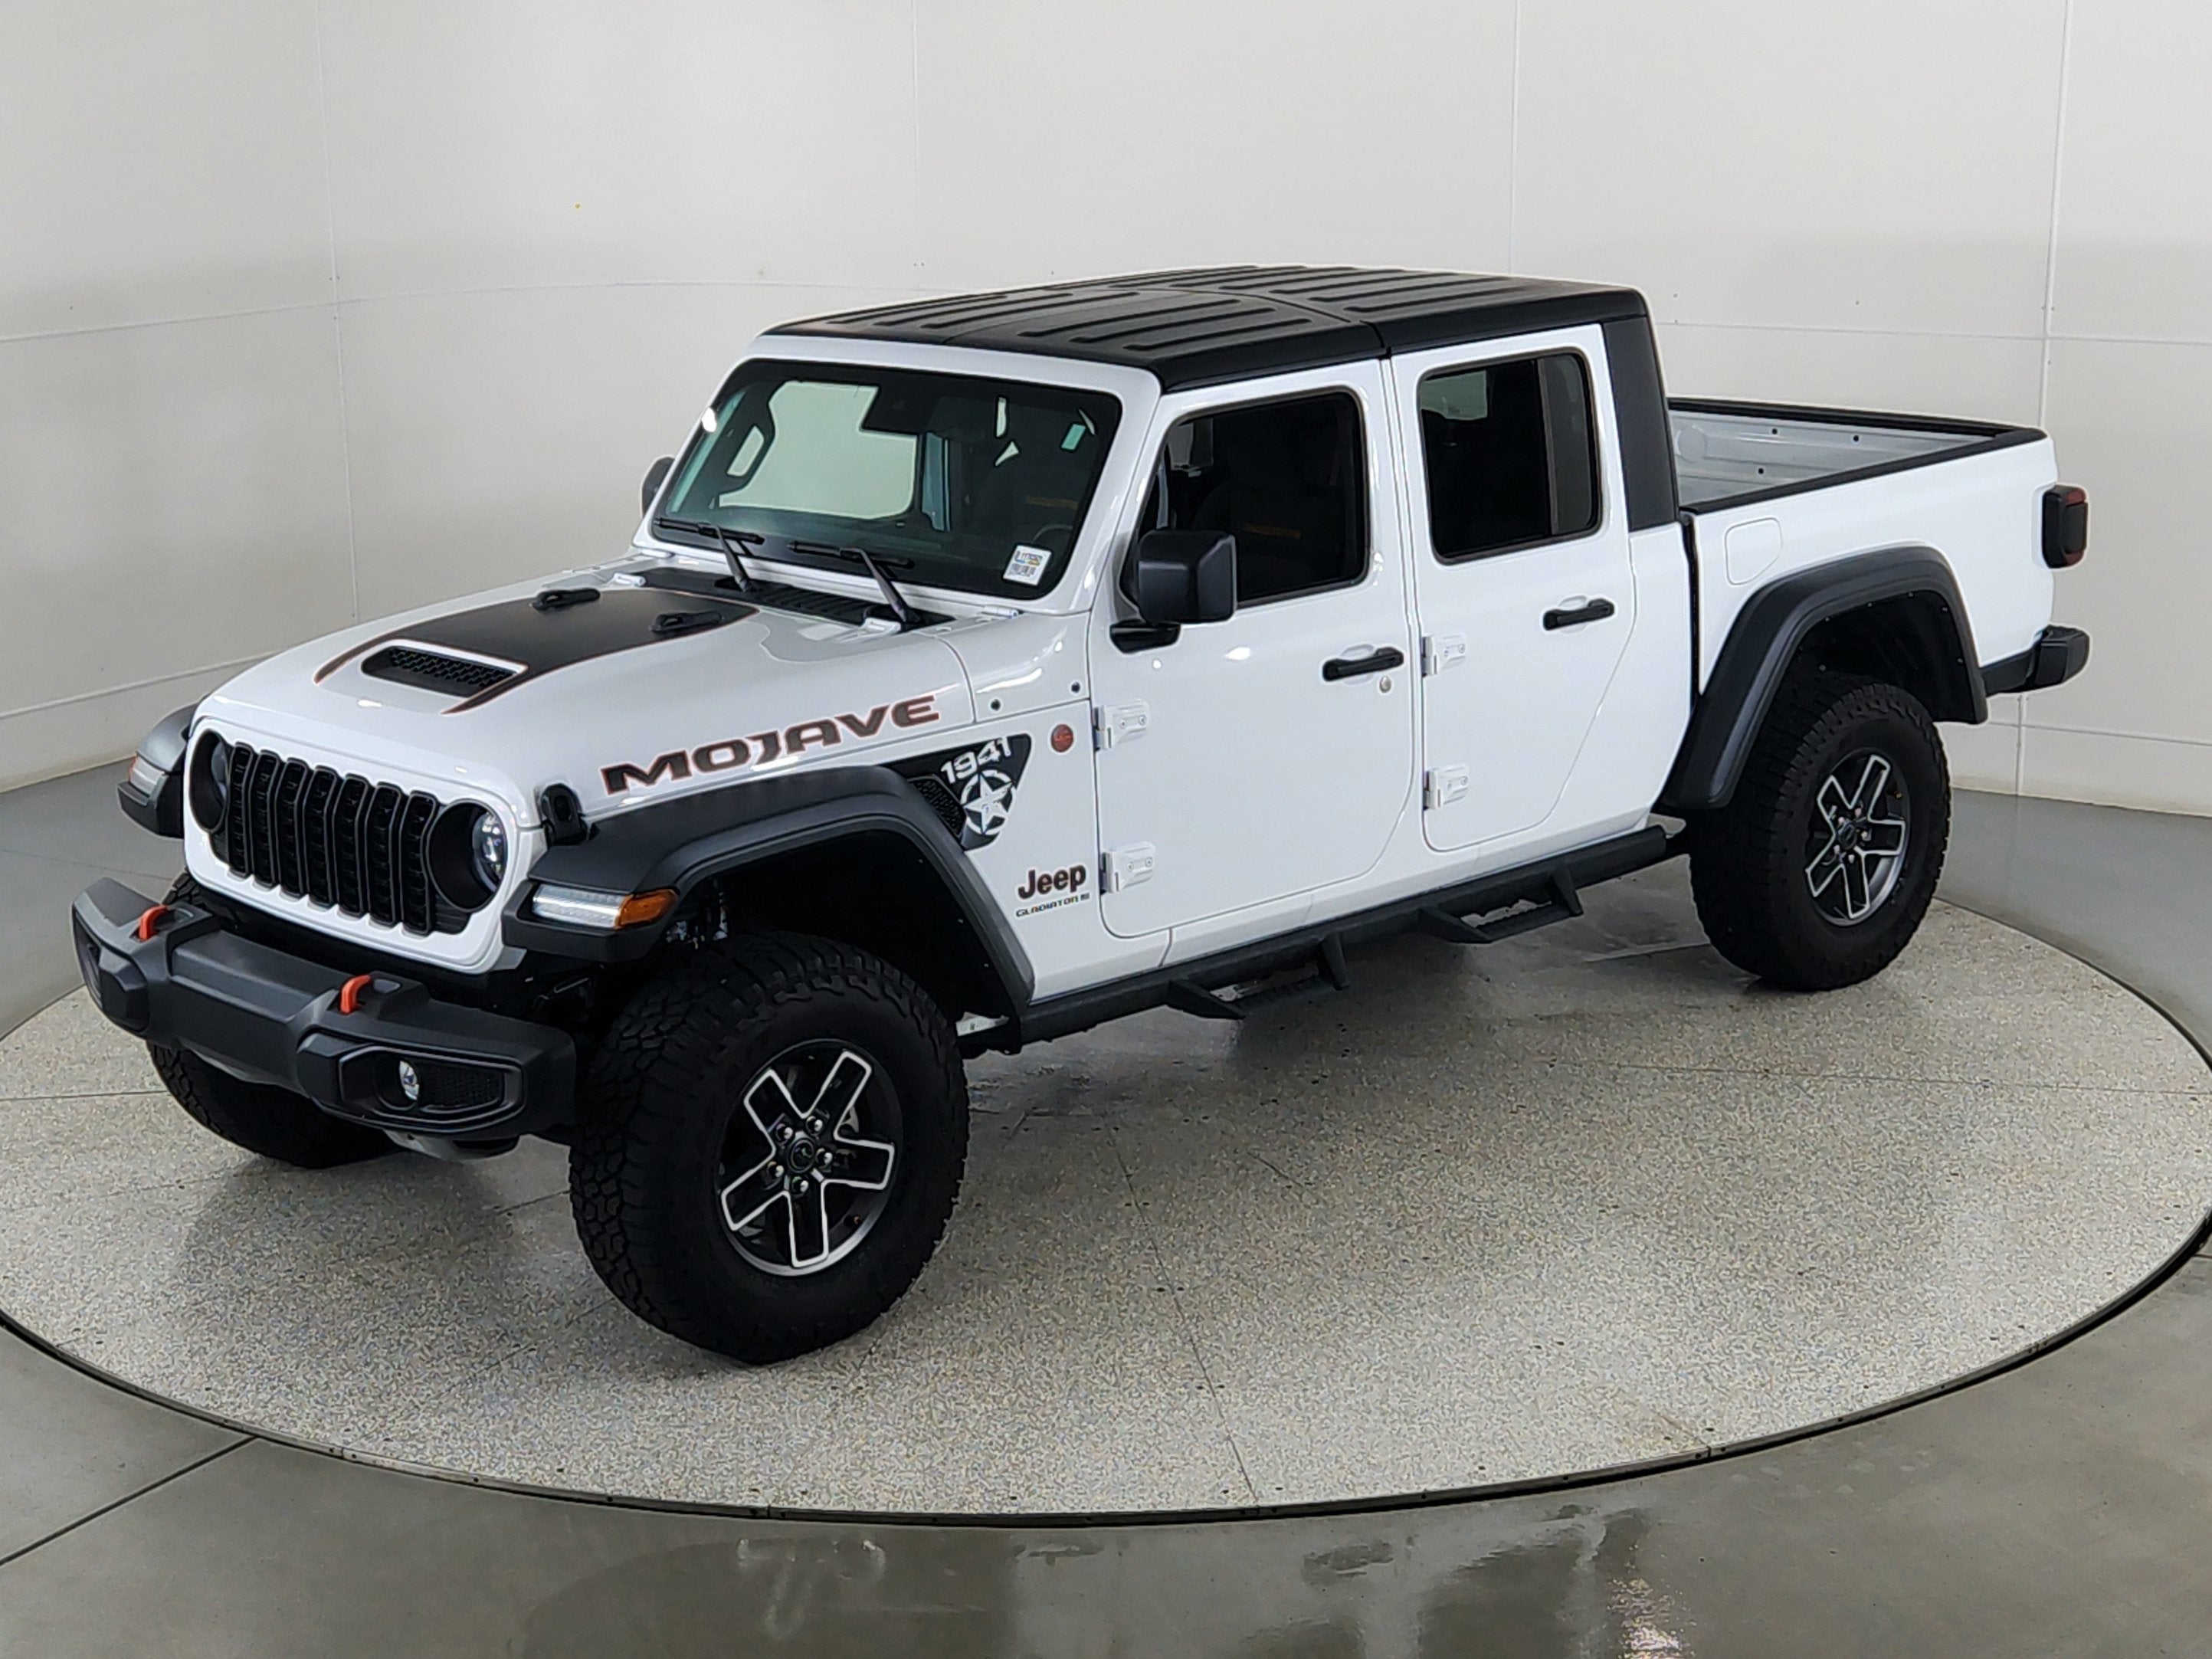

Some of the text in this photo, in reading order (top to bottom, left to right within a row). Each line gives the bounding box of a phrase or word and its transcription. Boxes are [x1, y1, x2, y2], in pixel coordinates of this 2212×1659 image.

[601, 694, 939, 795] MOJAVE
[941, 736, 1011, 784] 1941
[1018, 864, 1086, 900] Jeep
[1016, 895, 1079, 917] GLADIATOR
